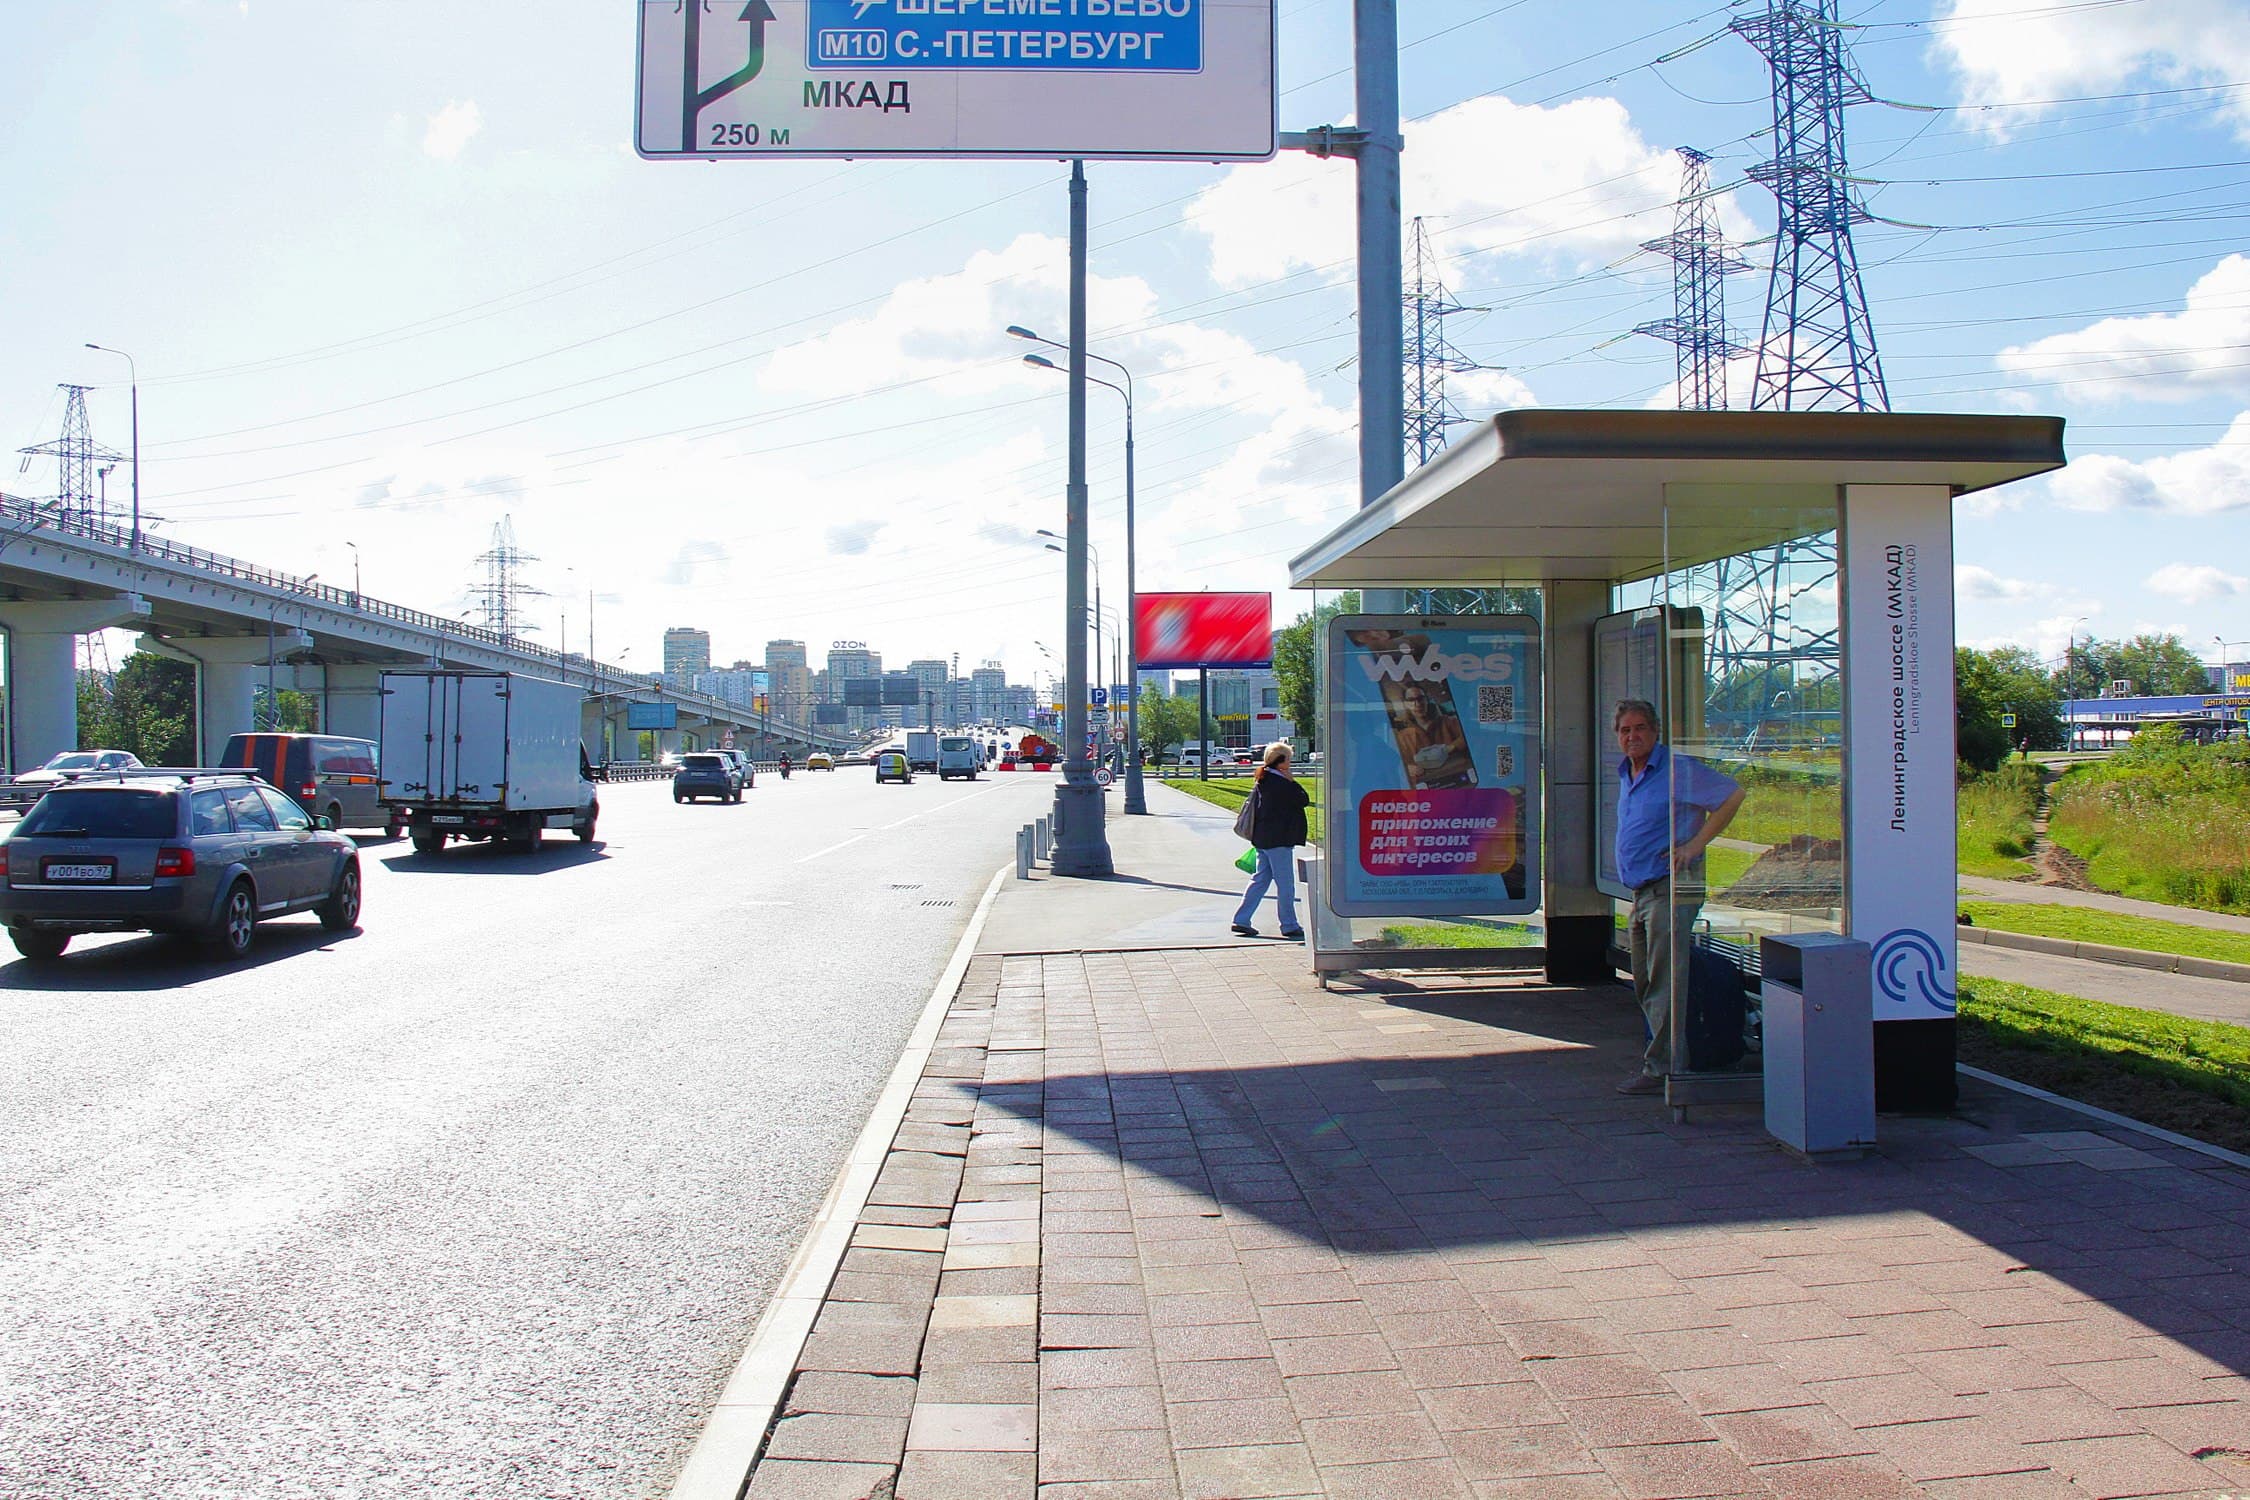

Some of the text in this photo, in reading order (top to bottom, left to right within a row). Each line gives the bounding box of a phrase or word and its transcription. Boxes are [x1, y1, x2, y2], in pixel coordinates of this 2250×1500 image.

[894, 30, 1165, 60] С.-ПЕТЕРБУРГ
[803, 81, 911, 114] МКАД
[711, 123, 790, 146] 250 м
[832, 640, 867, 649] OZON
[1904, 544, 1921, 734] Leningradskoe Shosse (MKAD)
[987, 660, 1002, 668] ВТБ
[1358, 643, 1514, 682] vibes
[1095, 690, 1104, 702] P
[1885, 544, 1908, 833] Ленинградское шоссе (МКАД)
[1098, 773, 1109, 781] 60
[1370, 801, 1432, 814] новое
[1370, 817, 1497, 834] приложение
[1370, 835, 1470, 850] для твоих
[1371, 851, 1478, 868] интересов
